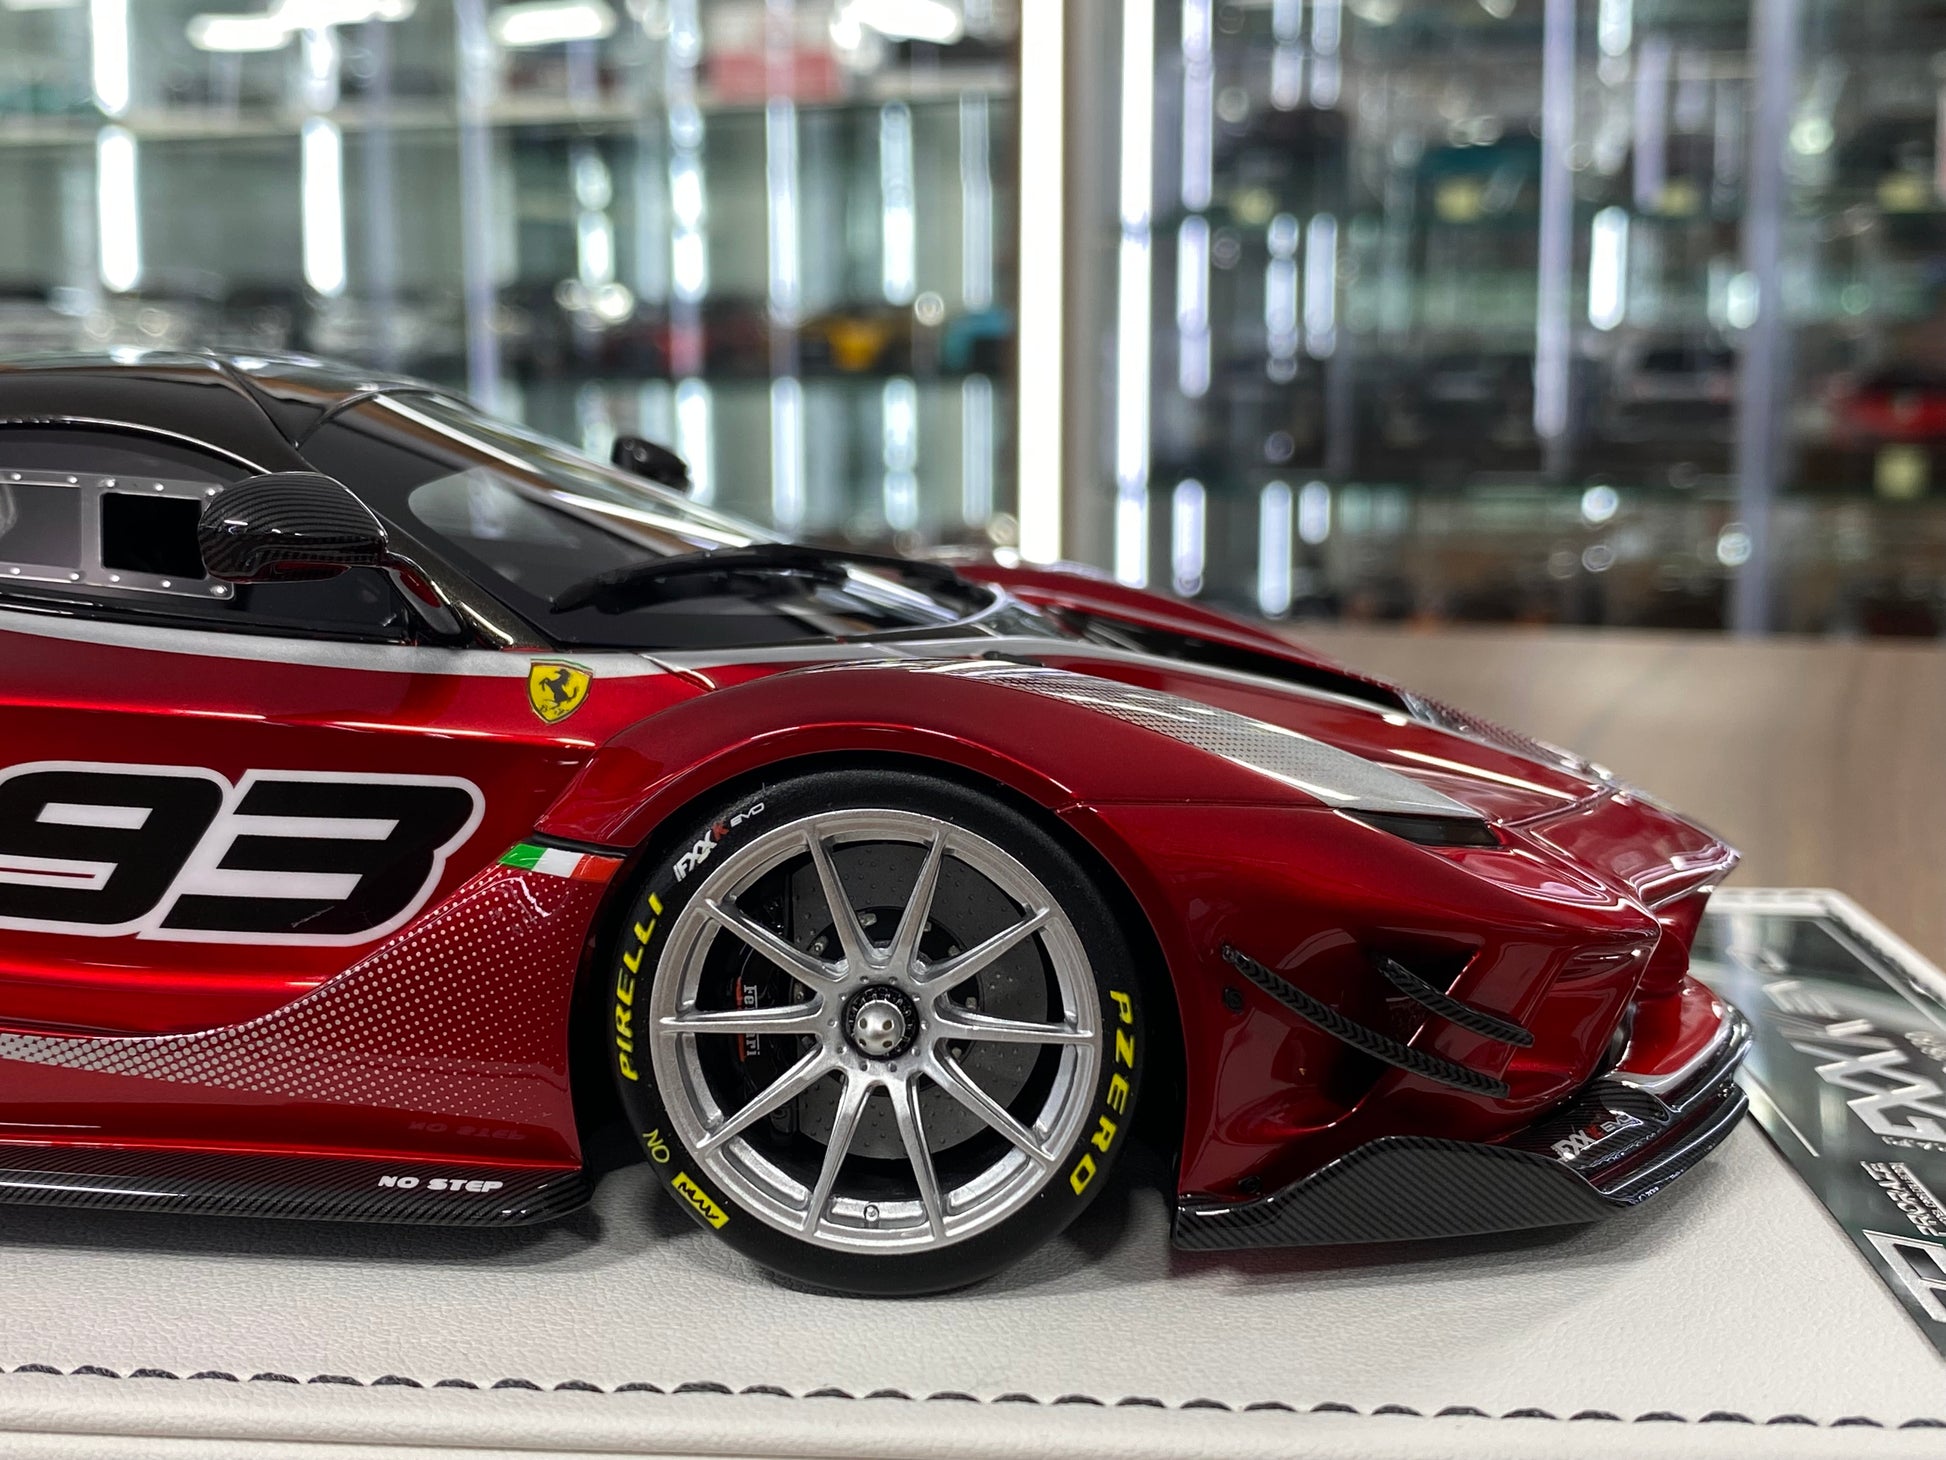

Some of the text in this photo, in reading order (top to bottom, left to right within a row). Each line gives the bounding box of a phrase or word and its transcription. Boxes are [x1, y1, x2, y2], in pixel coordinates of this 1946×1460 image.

[0, 760, 485, 947] 93
[730, 802, 765, 828] EVO
[614, 892, 664, 1081] PIRELLI
[378, 1175, 503, 1193] NO STEP
